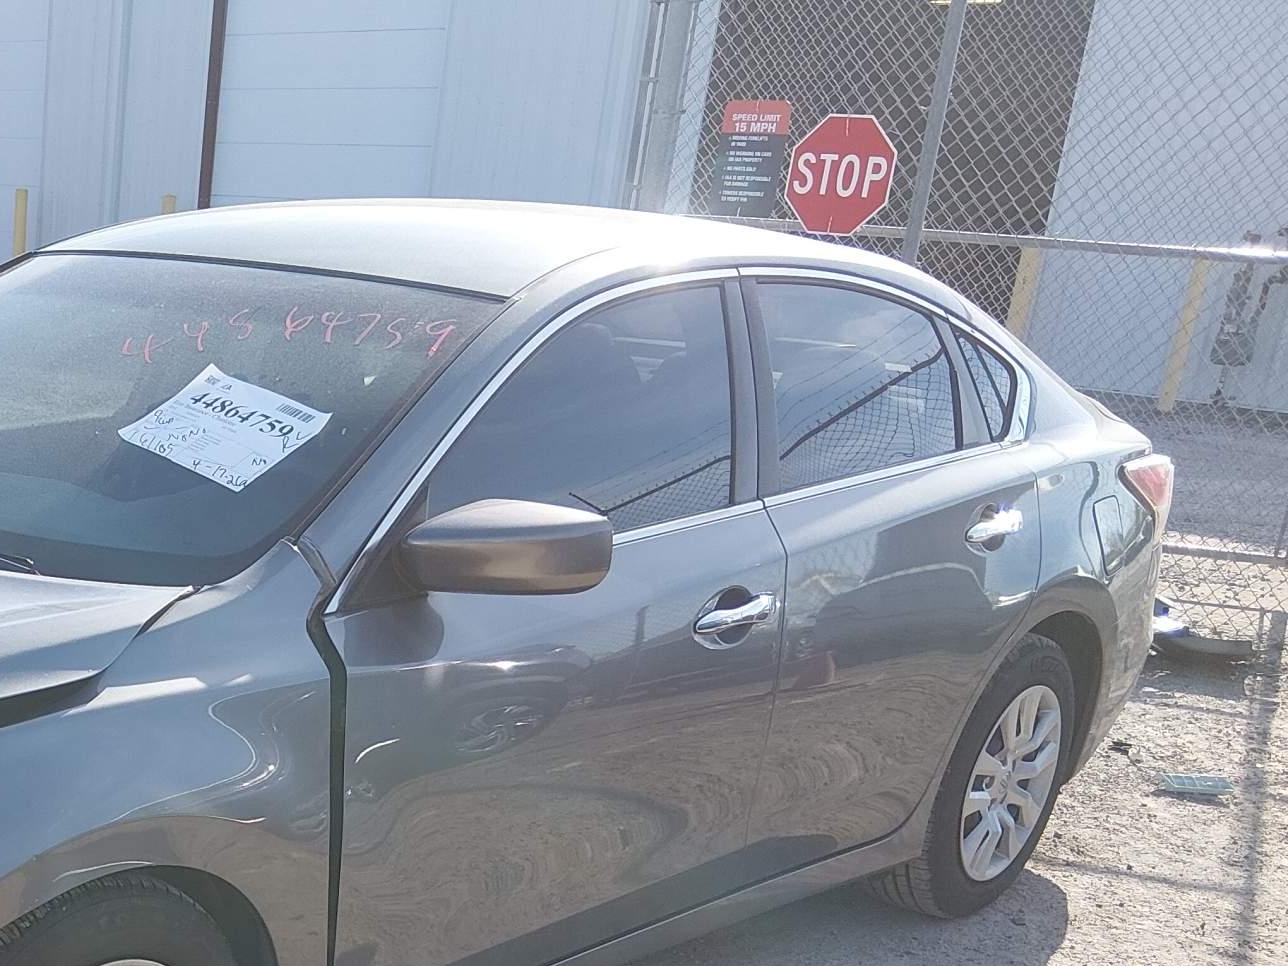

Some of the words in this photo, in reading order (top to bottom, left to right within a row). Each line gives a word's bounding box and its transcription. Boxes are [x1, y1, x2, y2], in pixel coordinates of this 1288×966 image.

[732, 113, 758, 122] SPEED
[759, 114, 782, 122] LIMIT
[734, 123, 747, 132] 15
[749, 122, 777, 133] MPH
[793, 152, 888, 199] STOP
[190, 392, 295, 438] 44864759
